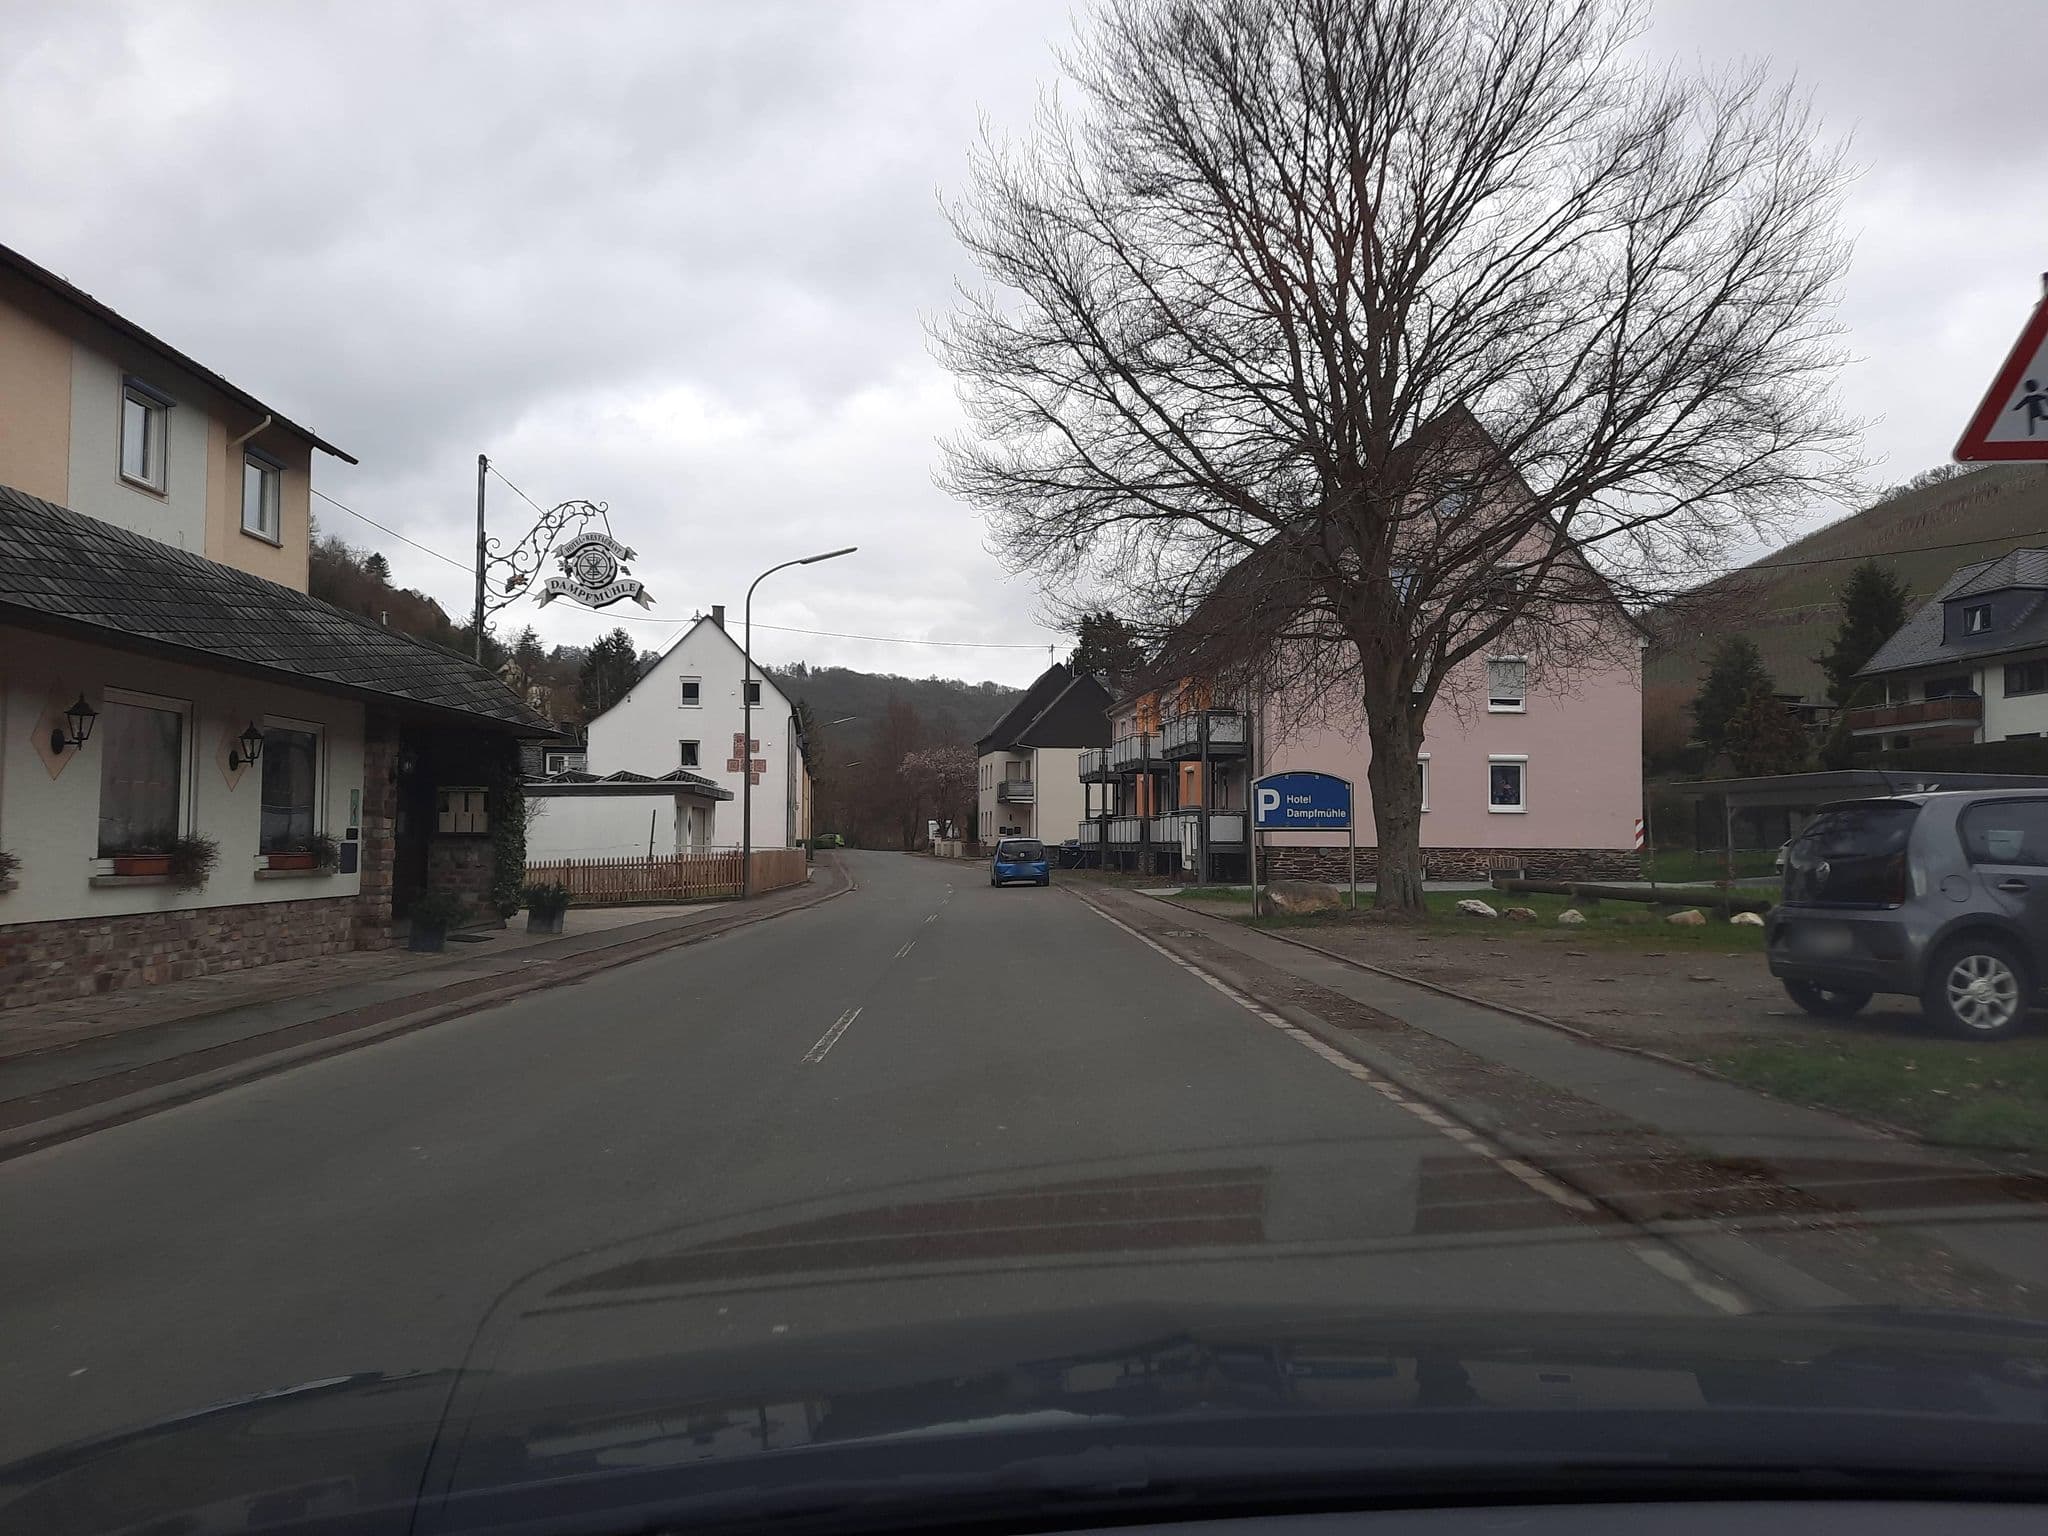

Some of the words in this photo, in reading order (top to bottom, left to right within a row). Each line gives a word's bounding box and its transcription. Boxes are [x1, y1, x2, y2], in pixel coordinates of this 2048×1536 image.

[1286, 795, 1312, 804] Hotel
[1258, 789, 1280, 822] P
[1286, 808, 1347, 819] Dampfmühle
